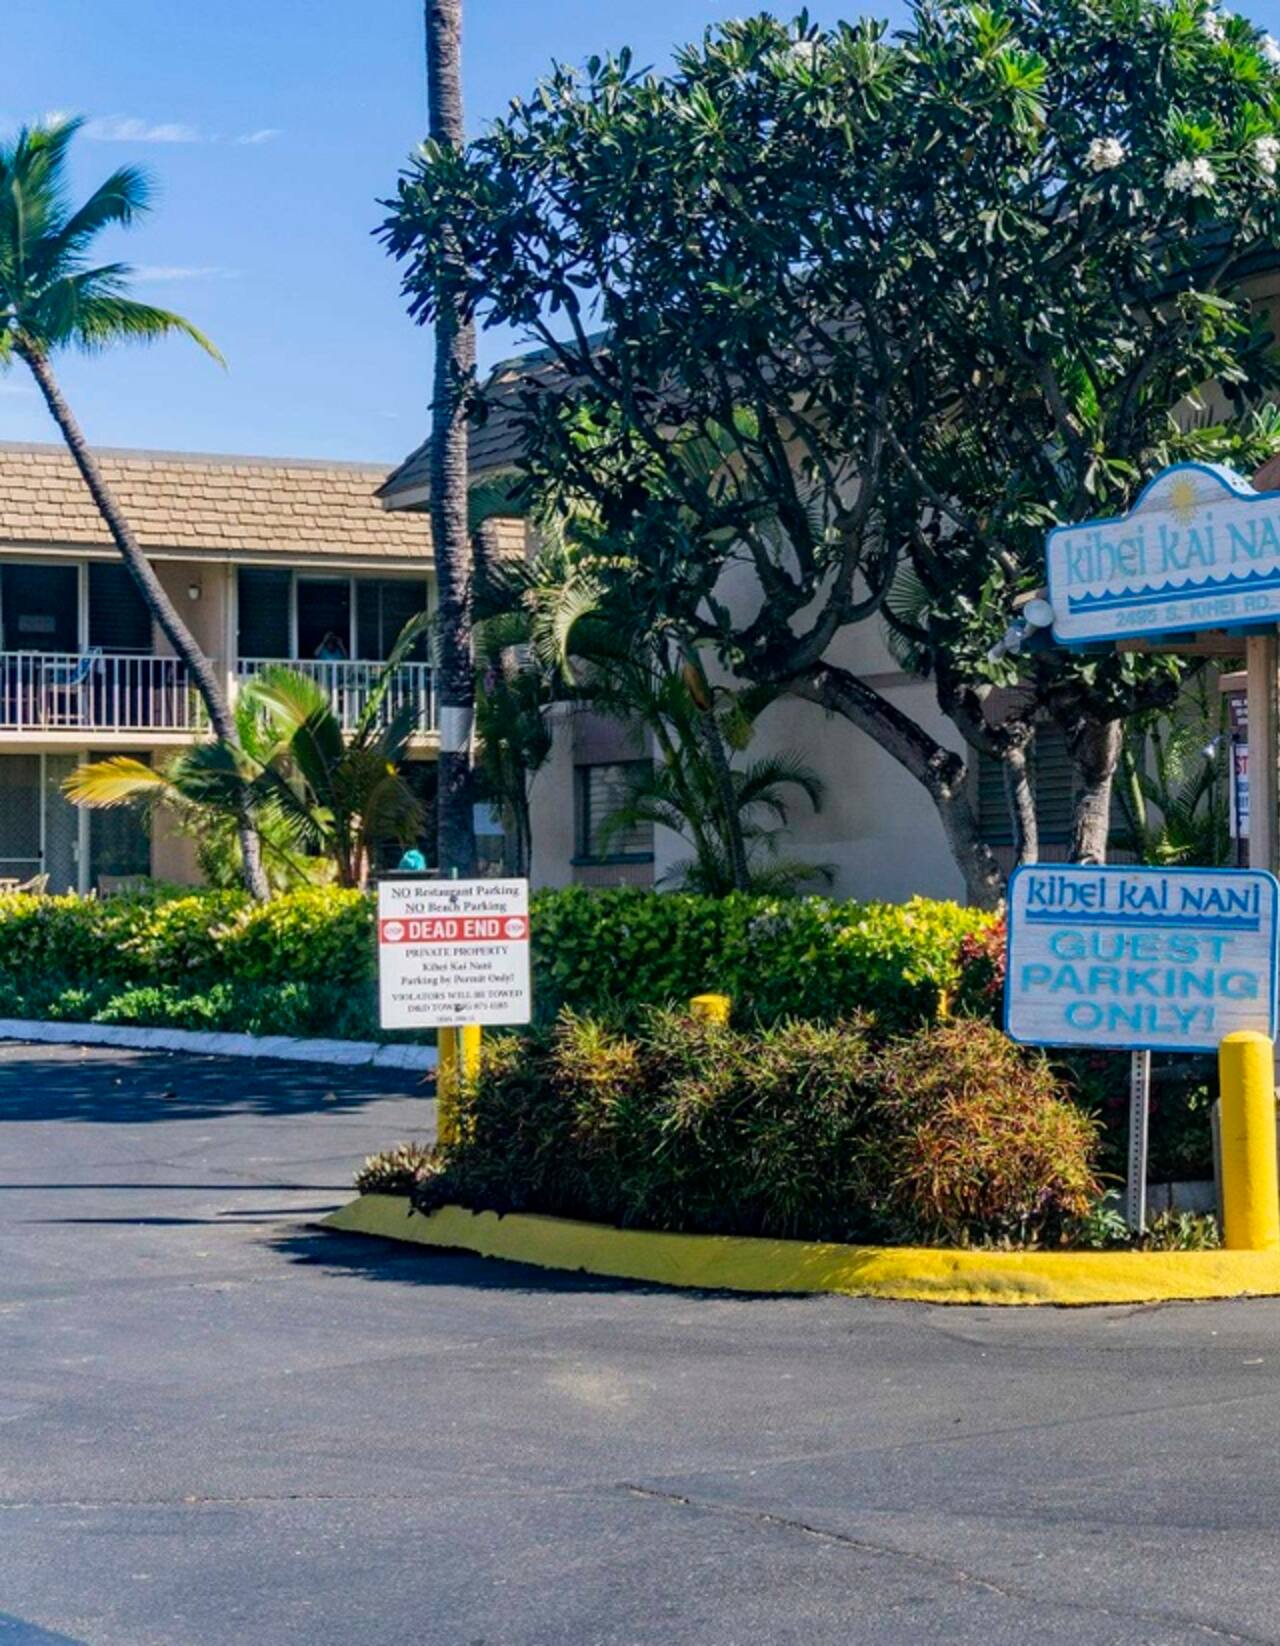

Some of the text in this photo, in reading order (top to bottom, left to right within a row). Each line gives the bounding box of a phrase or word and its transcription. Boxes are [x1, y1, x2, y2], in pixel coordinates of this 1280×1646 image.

[1190, 599, 1237, 618] KIHEI
[391, 885, 519, 898] NO Restaurant Parking
[405, 901, 507, 913] NO Beach Parking
[408, 920, 458, 939] DEAD
[463, 919, 500, 938] END
[405, 946, 509, 958] PRIVATE PROPERTY
[1050, 930, 1235, 964] GUEST
[401, 976, 438, 986] Parking
[1020, 963, 1259, 1000] PARKING
[391, 992, 446, 1002] VIOLATORS
[447, 991, 472, 1000] WILL
[488, 989, 524, 999] TOWED
[1064, 1001, 1216, 1035] ONLY!
